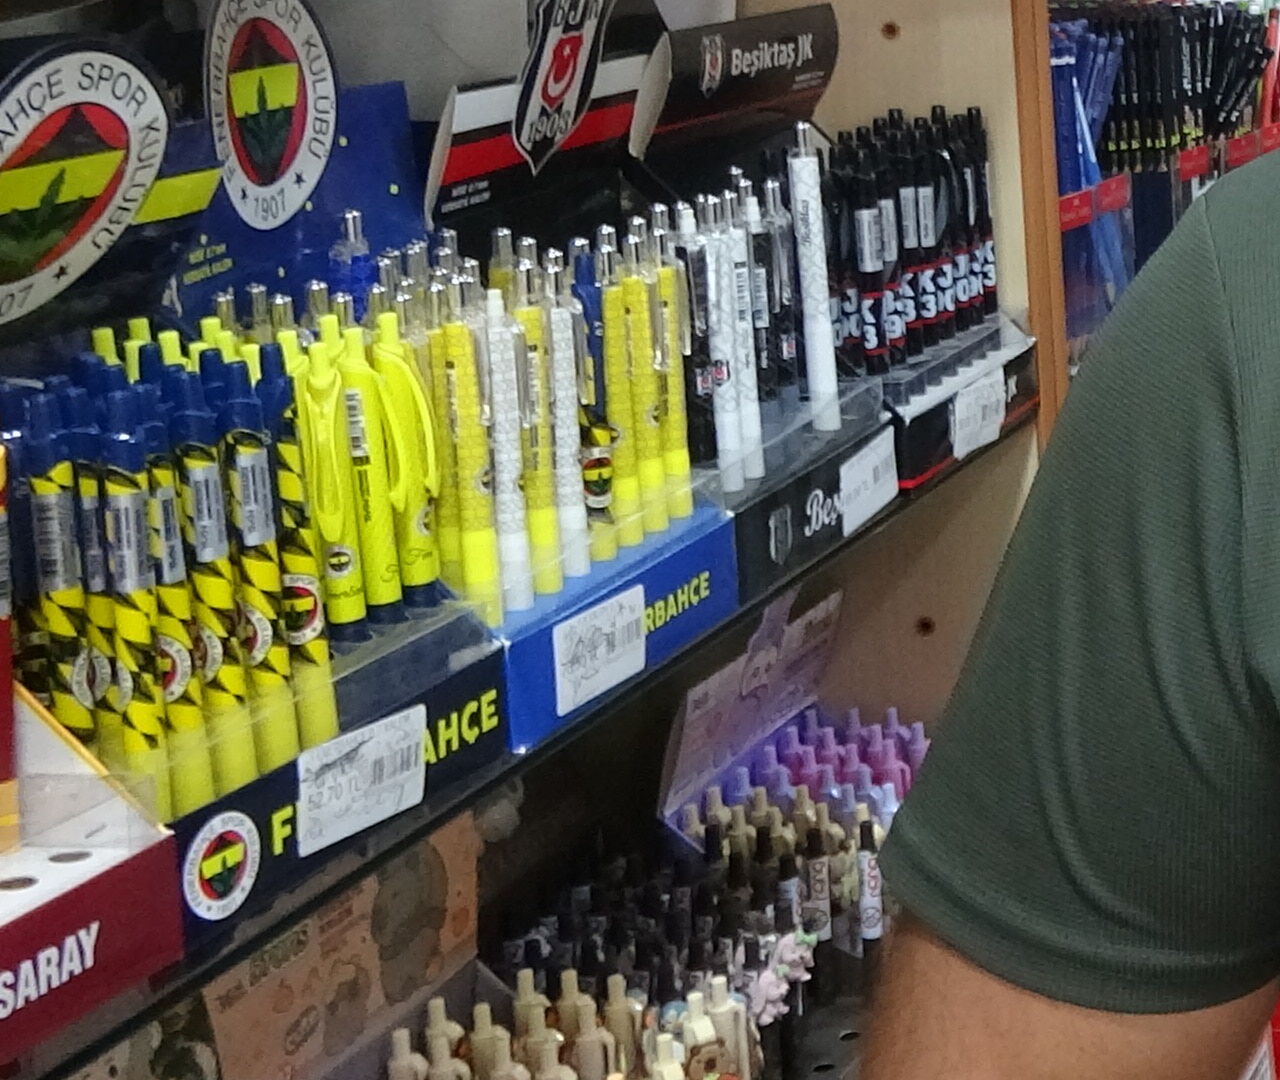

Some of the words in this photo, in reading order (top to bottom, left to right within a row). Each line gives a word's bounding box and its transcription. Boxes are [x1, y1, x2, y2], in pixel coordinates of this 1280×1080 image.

[730, 40, 797, 78] Beşiktaş
[797, 32, 814, 67] JK
[0, 68, 66, 153] AHÇE
[77, 61, 149, 118] SPOR
[301, 32, 335, 161] KULÜBÜ
[252, 186, 288, 221] 1907
[0, 283, 35, 318] 07
[640, 570, 711, 636] RBAHÇE
[0, 919, 100, 1020] SARAY
